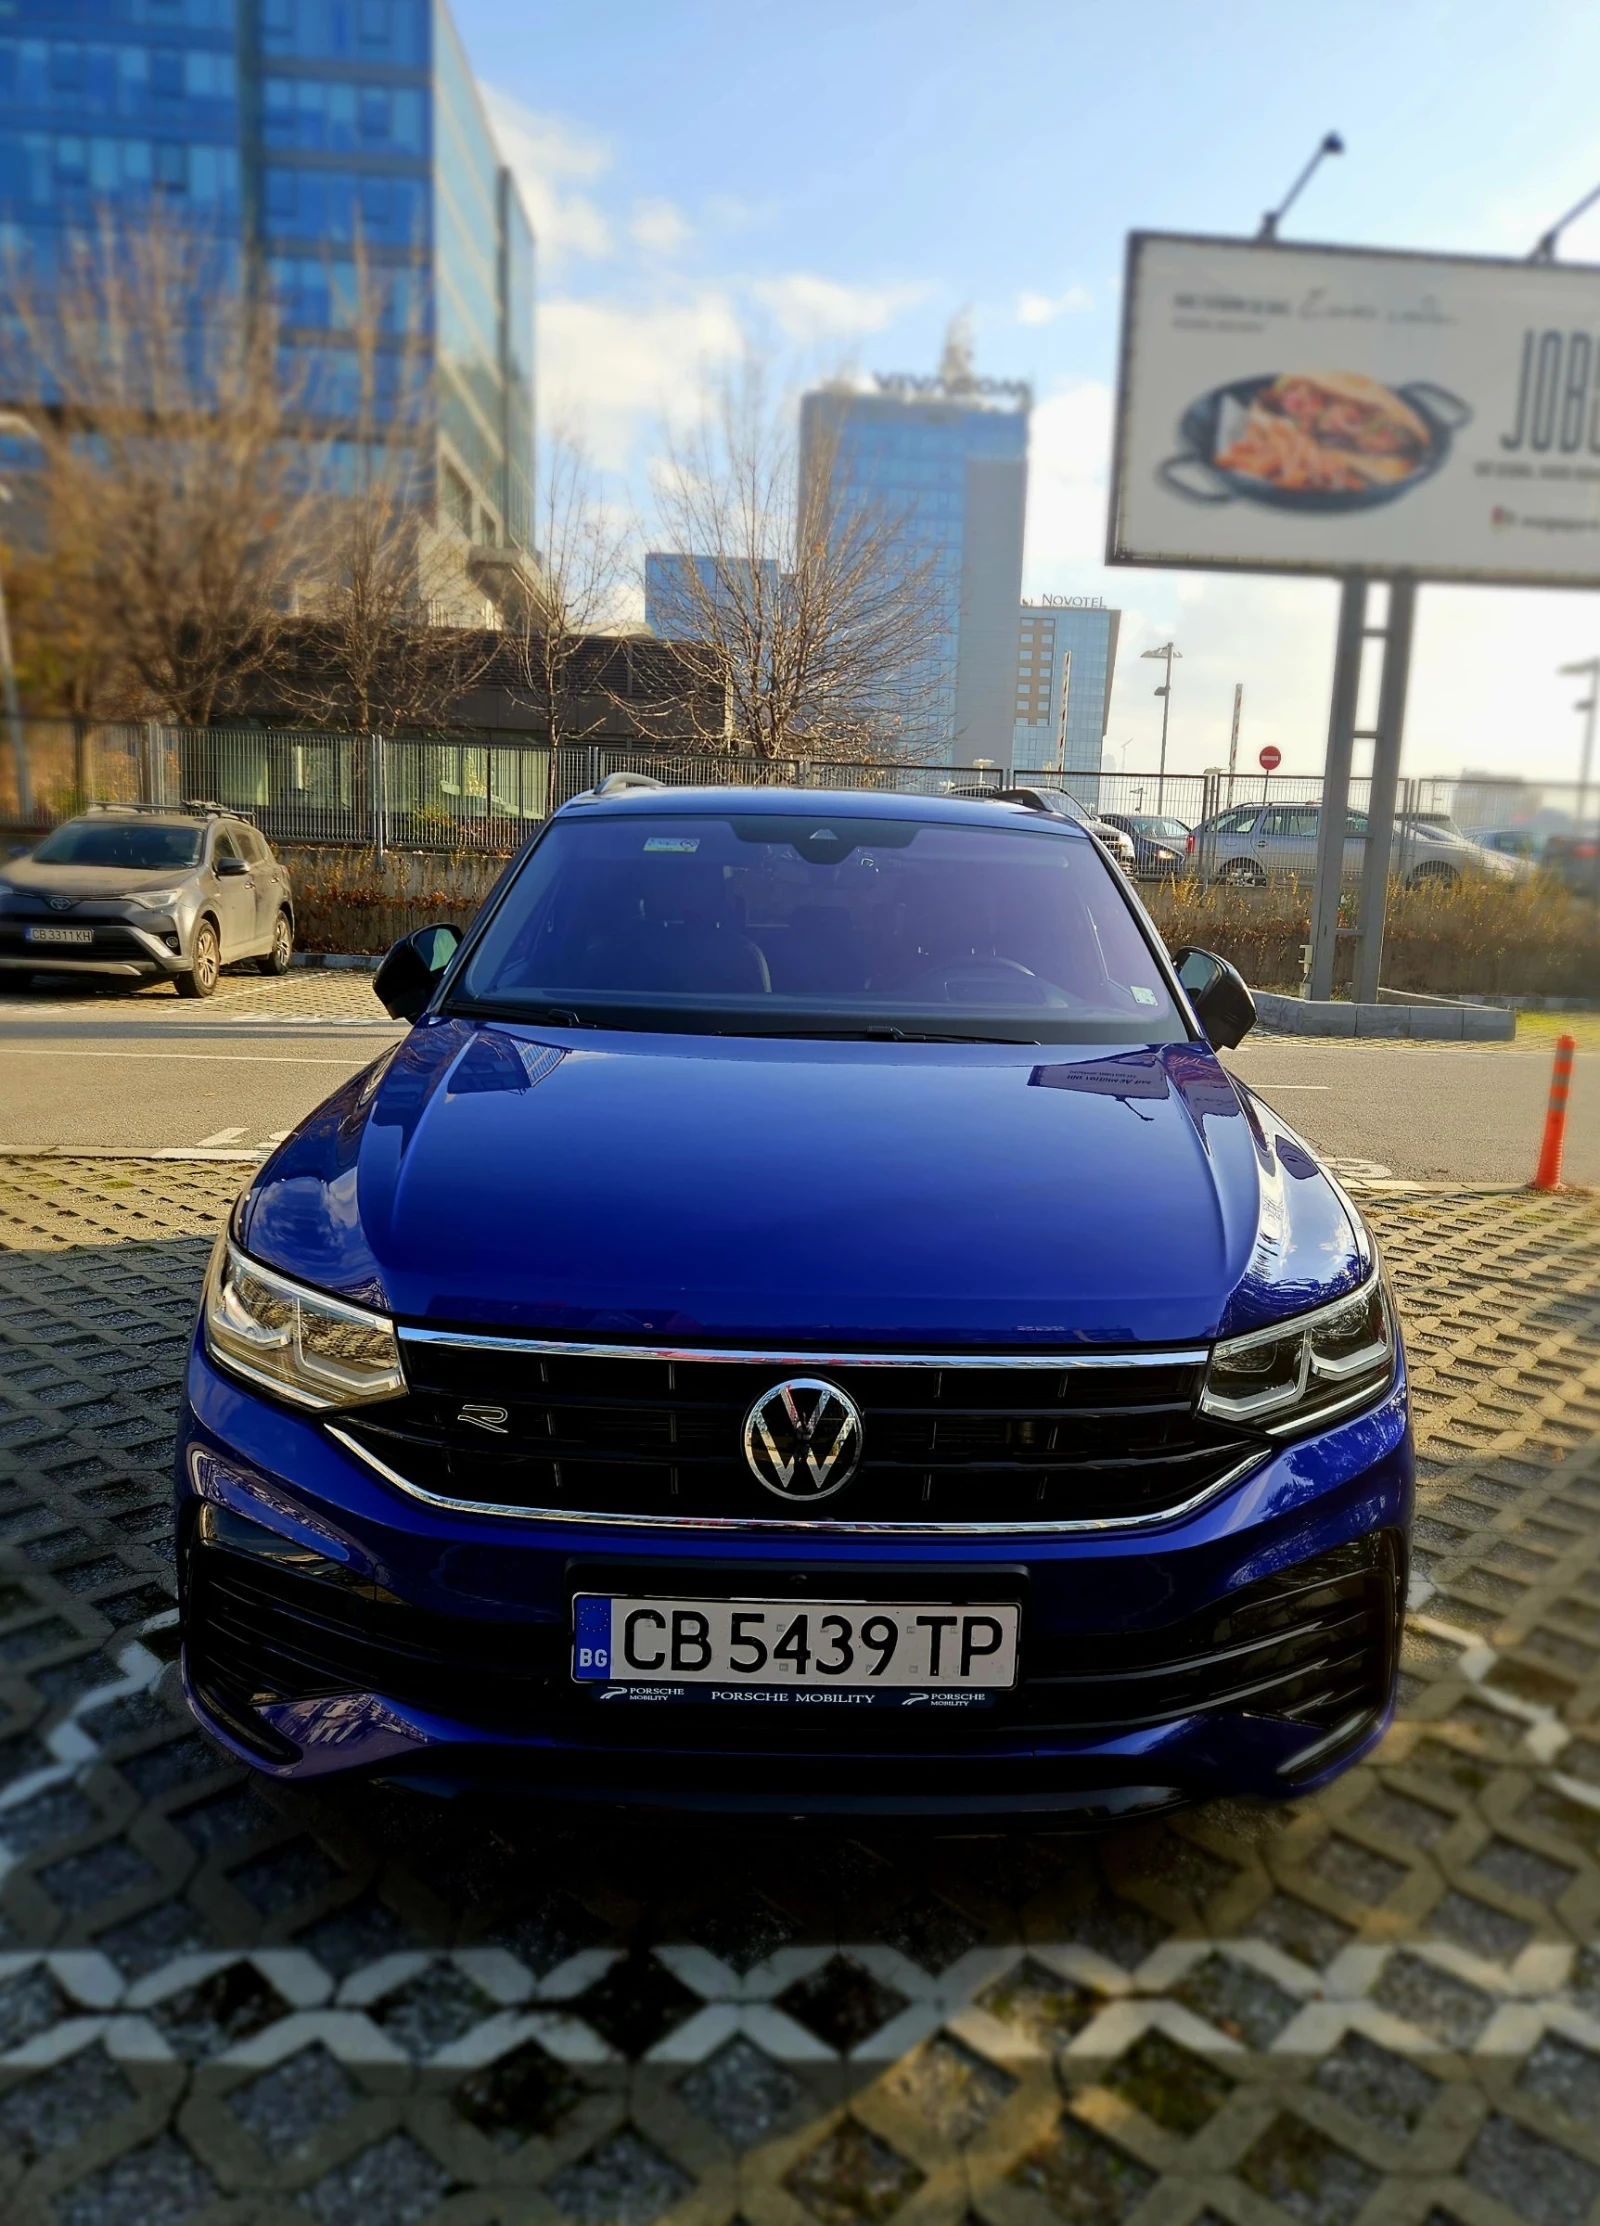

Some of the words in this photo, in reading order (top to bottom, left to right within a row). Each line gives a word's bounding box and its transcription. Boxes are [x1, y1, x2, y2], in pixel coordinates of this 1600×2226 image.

[1499, 326, 1600, 453] JOB
[32, 929, 46, 940] CB
[48, 930, 73, 941] 3311
[76, 931, 91, 942] KH
[457, 1404, 509, 1434] R
[624, 1609, 711, 1671] CB
[730, 1613, 899, 1676] 5439
[916, 1616, 1003, 1676] TP
[579, 1648, 607, 1667] BG
[629, 1687, 685, 1696] PORSCHE
[711, 1691, 789, 1702] PORSCHE
[795, 1693, 876, 1704] MOBILITY
[930, 1693, 985, 1701] PORSCHE
